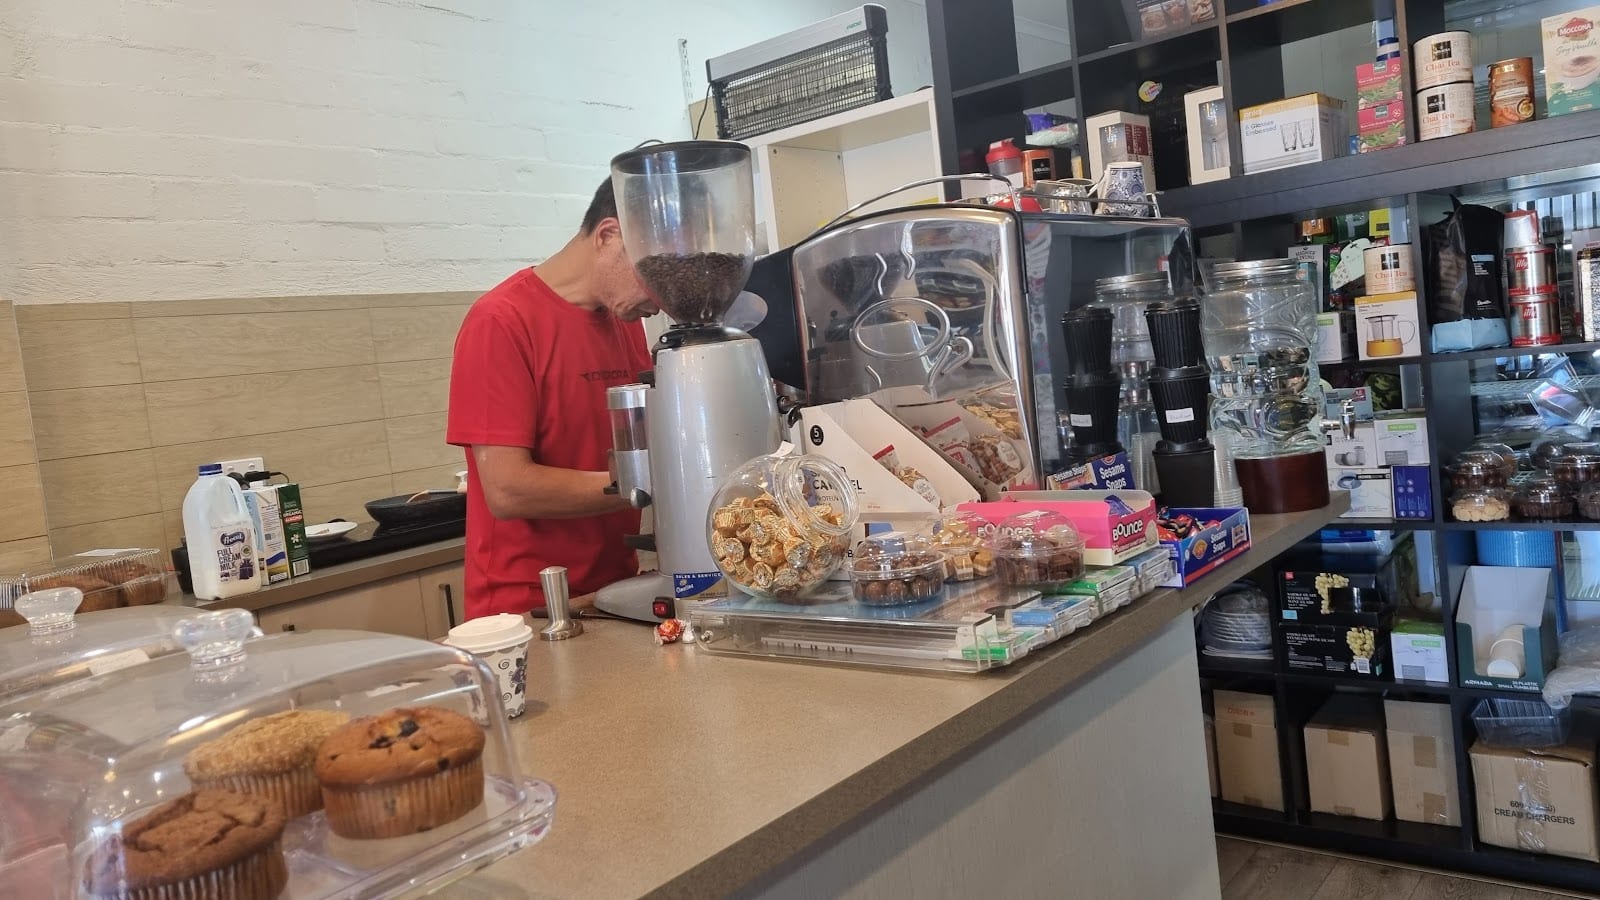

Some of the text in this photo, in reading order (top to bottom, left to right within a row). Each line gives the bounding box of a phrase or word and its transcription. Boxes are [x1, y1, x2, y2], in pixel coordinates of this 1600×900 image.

[1559, 23, 1592, 36] MOCCONA
[1425, 62, 1446, 72] Chai
[1423, 112, 1455, 124] Chai Tea
[1246, 124, 1277, 136] Embossed
[1251, 121, 1274, 129] Glasses
[1516, 259, 1528, 268] illy
[813, 428, 820, 438] 5
[1054, 465, 1088, 481] Sesame Snaps
[1099, 464, 1126, 480] Sesame
[813, 479, 862, 490] CAEL
[1105, 477, 1127, 490] Snaps
[1210, 530, 1227, 543] Sesame
[217, 548, 232, 557] FULL
[1213, 541, 1226, 554] Snaps
[218, 553, 241, 565] CREAM
[220, 561, 238, 571] MILK
[1494, 808, 1523, 818] CREAM
[1525, 812, 1575, 825] CHARGERS
